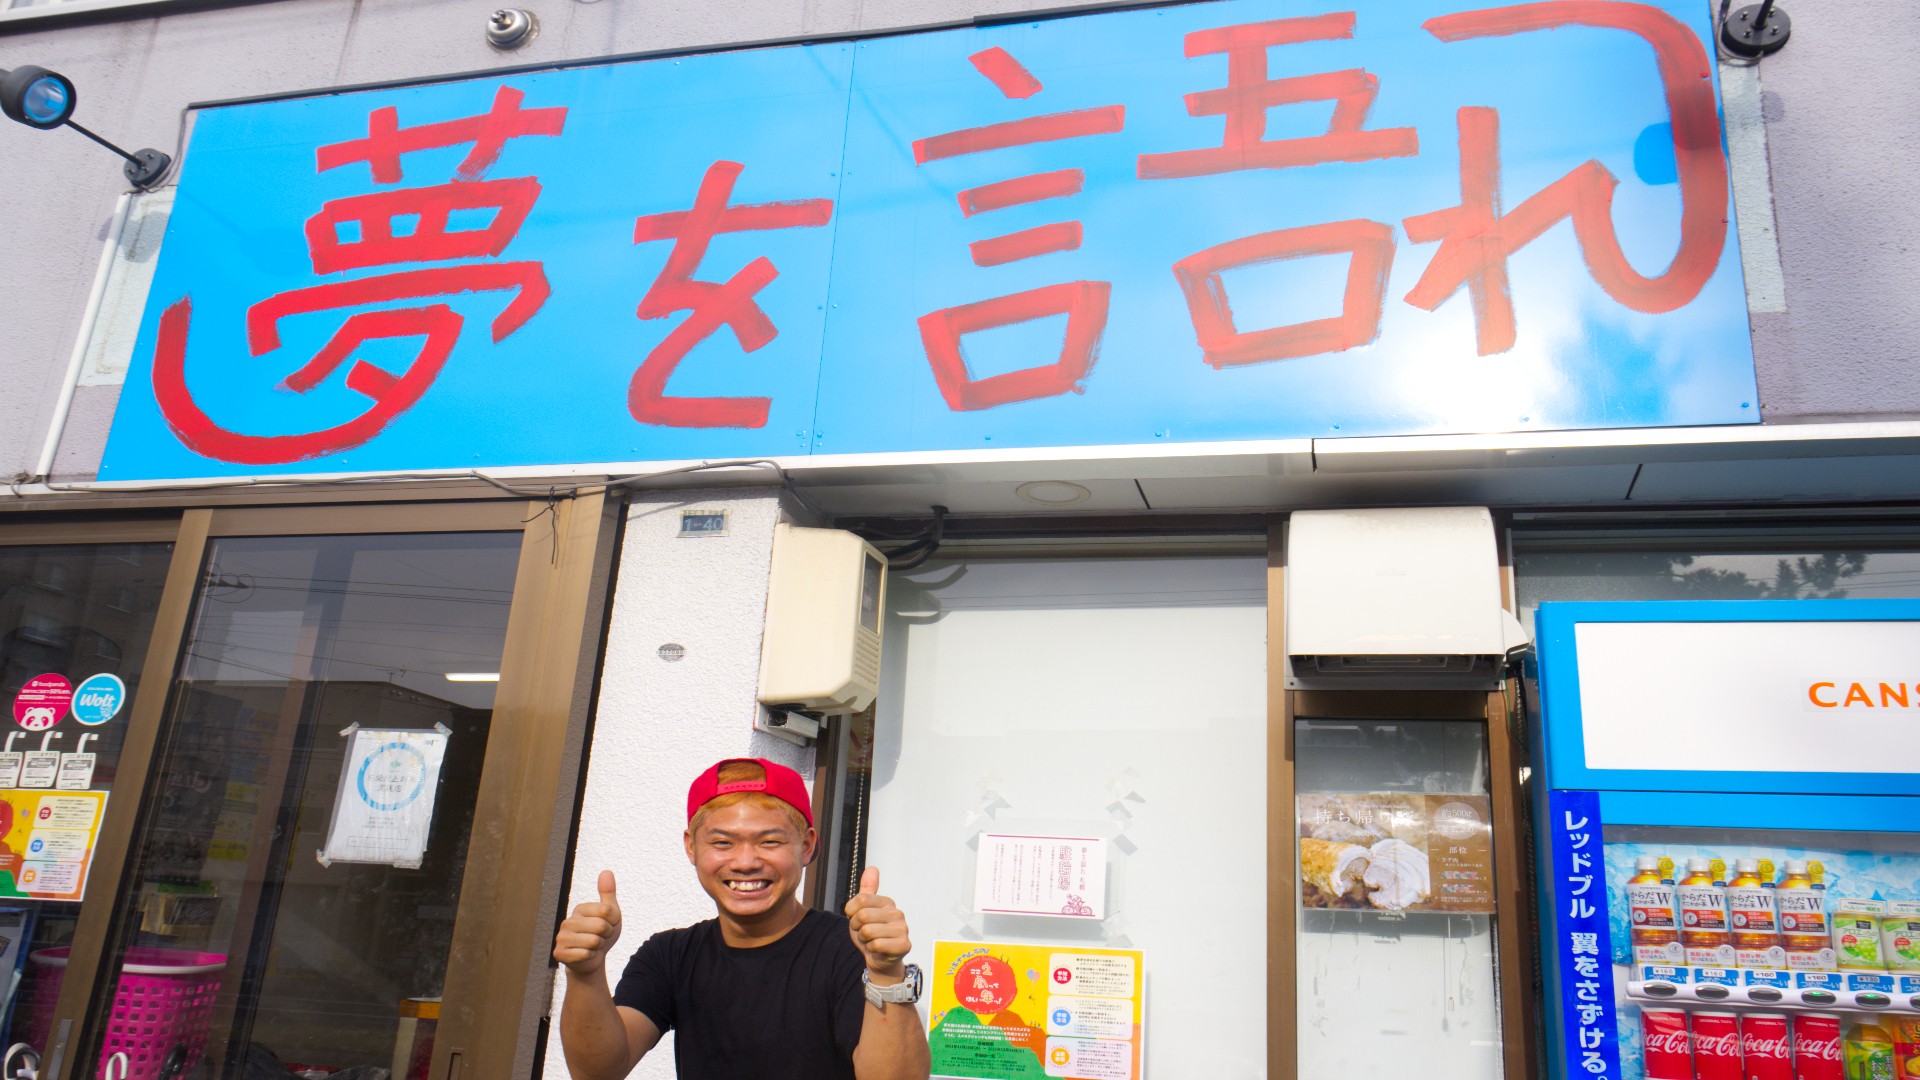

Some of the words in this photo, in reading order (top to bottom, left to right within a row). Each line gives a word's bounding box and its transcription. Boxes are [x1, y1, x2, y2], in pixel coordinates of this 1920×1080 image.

[152, 0, 1729, 465] 夢を語れ
[684, 517, 722, 531] 1-40
[79, 693, 116, 707] Wolt
[1808, 681, 1920, 708] CAN
[1564, 810, 1596, 919] レッドブル
[1657, 893, 1671, 905] W
[1709, 894, 1723, 907] W
[1756, 895, 1773, 908] W
[1806, 897, 1823, 910] W
